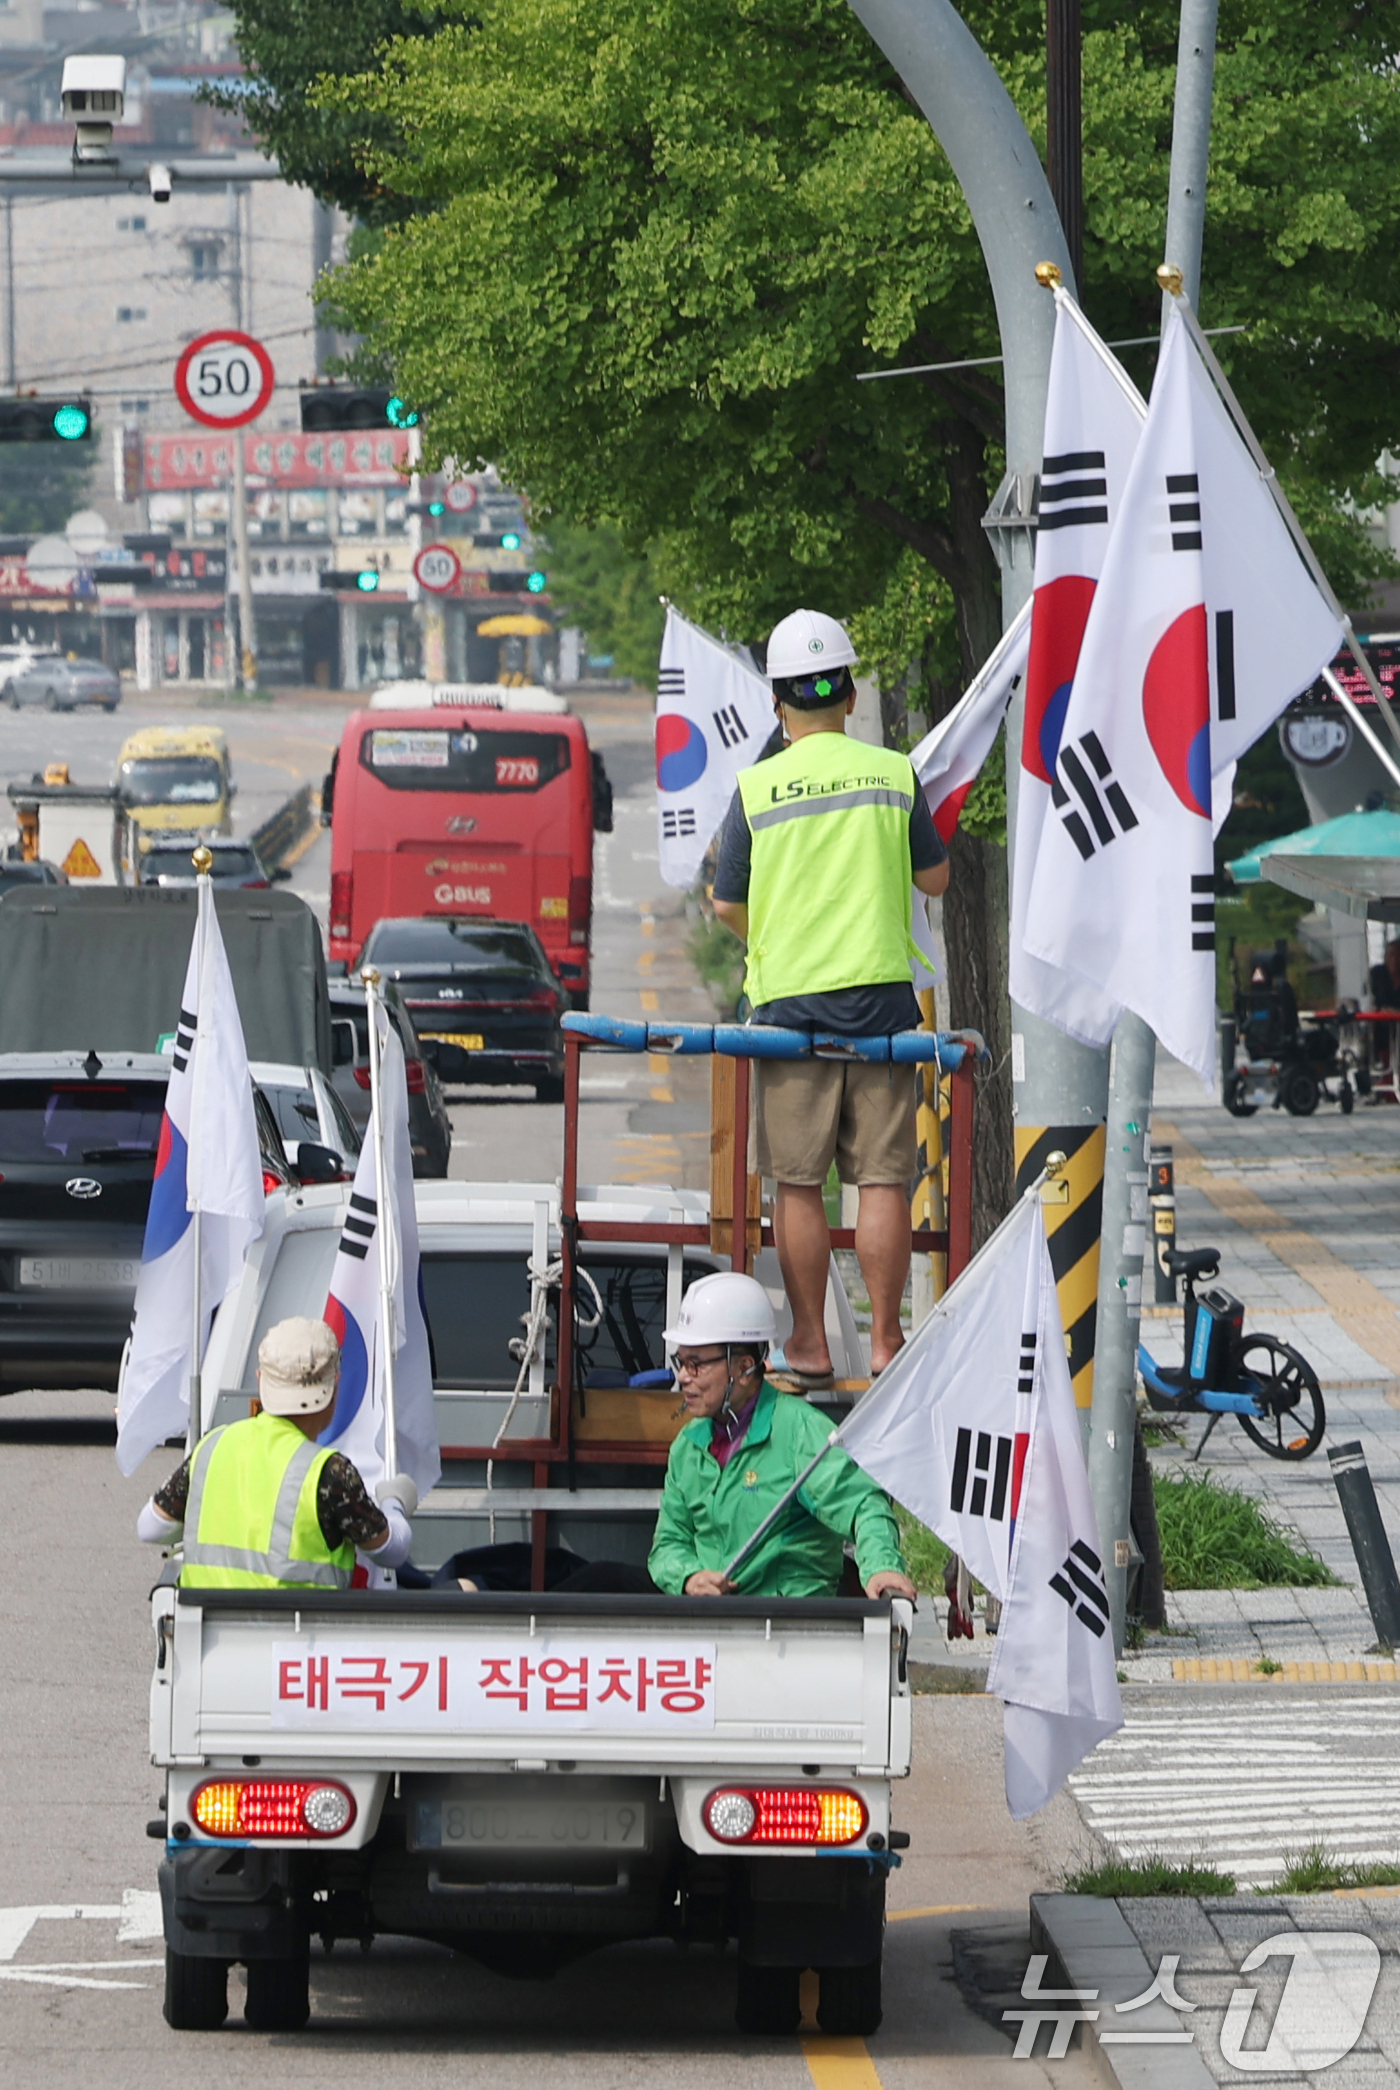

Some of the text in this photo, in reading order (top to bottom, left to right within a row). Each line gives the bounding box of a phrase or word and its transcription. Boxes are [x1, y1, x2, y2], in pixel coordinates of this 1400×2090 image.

[198, 360, 251, 397] 50
[425, 556, 450, 575] 50
[496, 761, 539, 782] 7770
[771, 776, 891, 803] LS ELECTRIC
[278, 1657, 712, 1714] 태극기 작업차량
